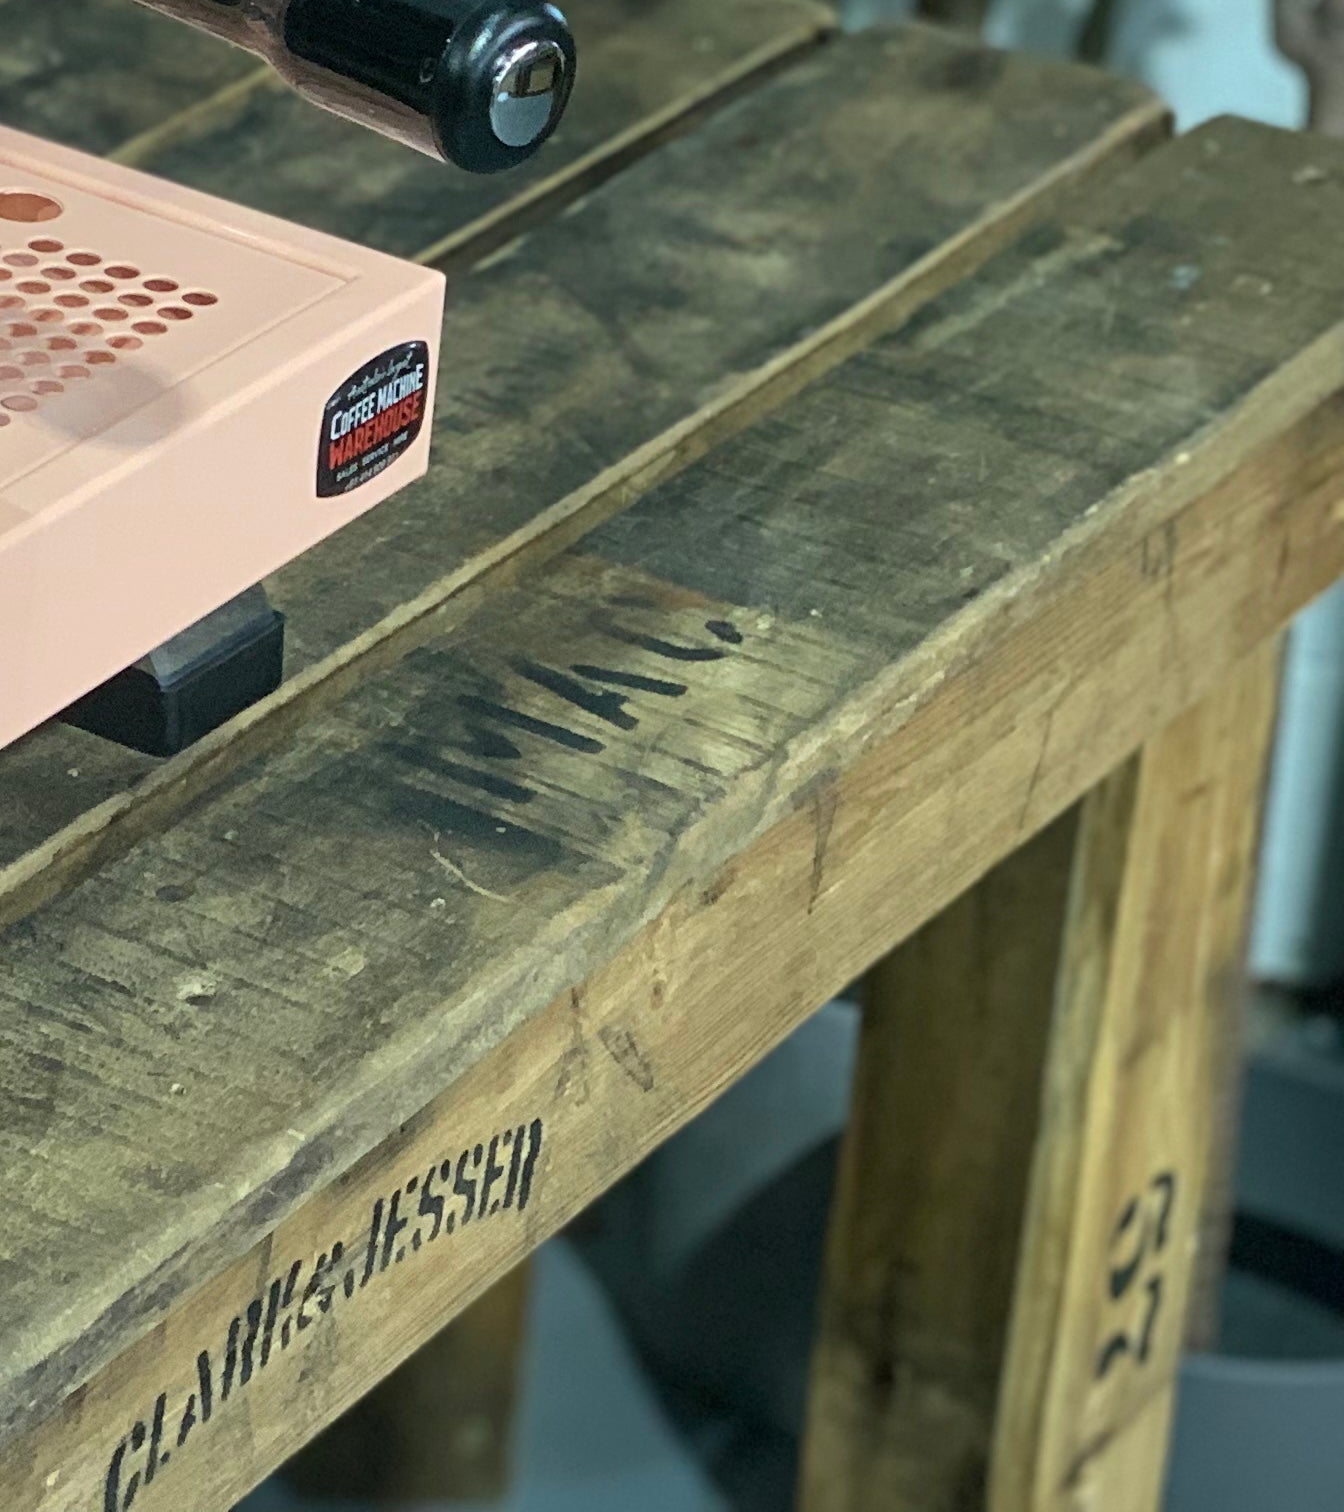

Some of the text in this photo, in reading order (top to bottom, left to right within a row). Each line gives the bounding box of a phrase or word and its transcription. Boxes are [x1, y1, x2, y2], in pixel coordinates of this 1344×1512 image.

[329, 390, 423, 470] WAREHOUSE
[330, 363, 424, 441] COFFEE MACHINE
